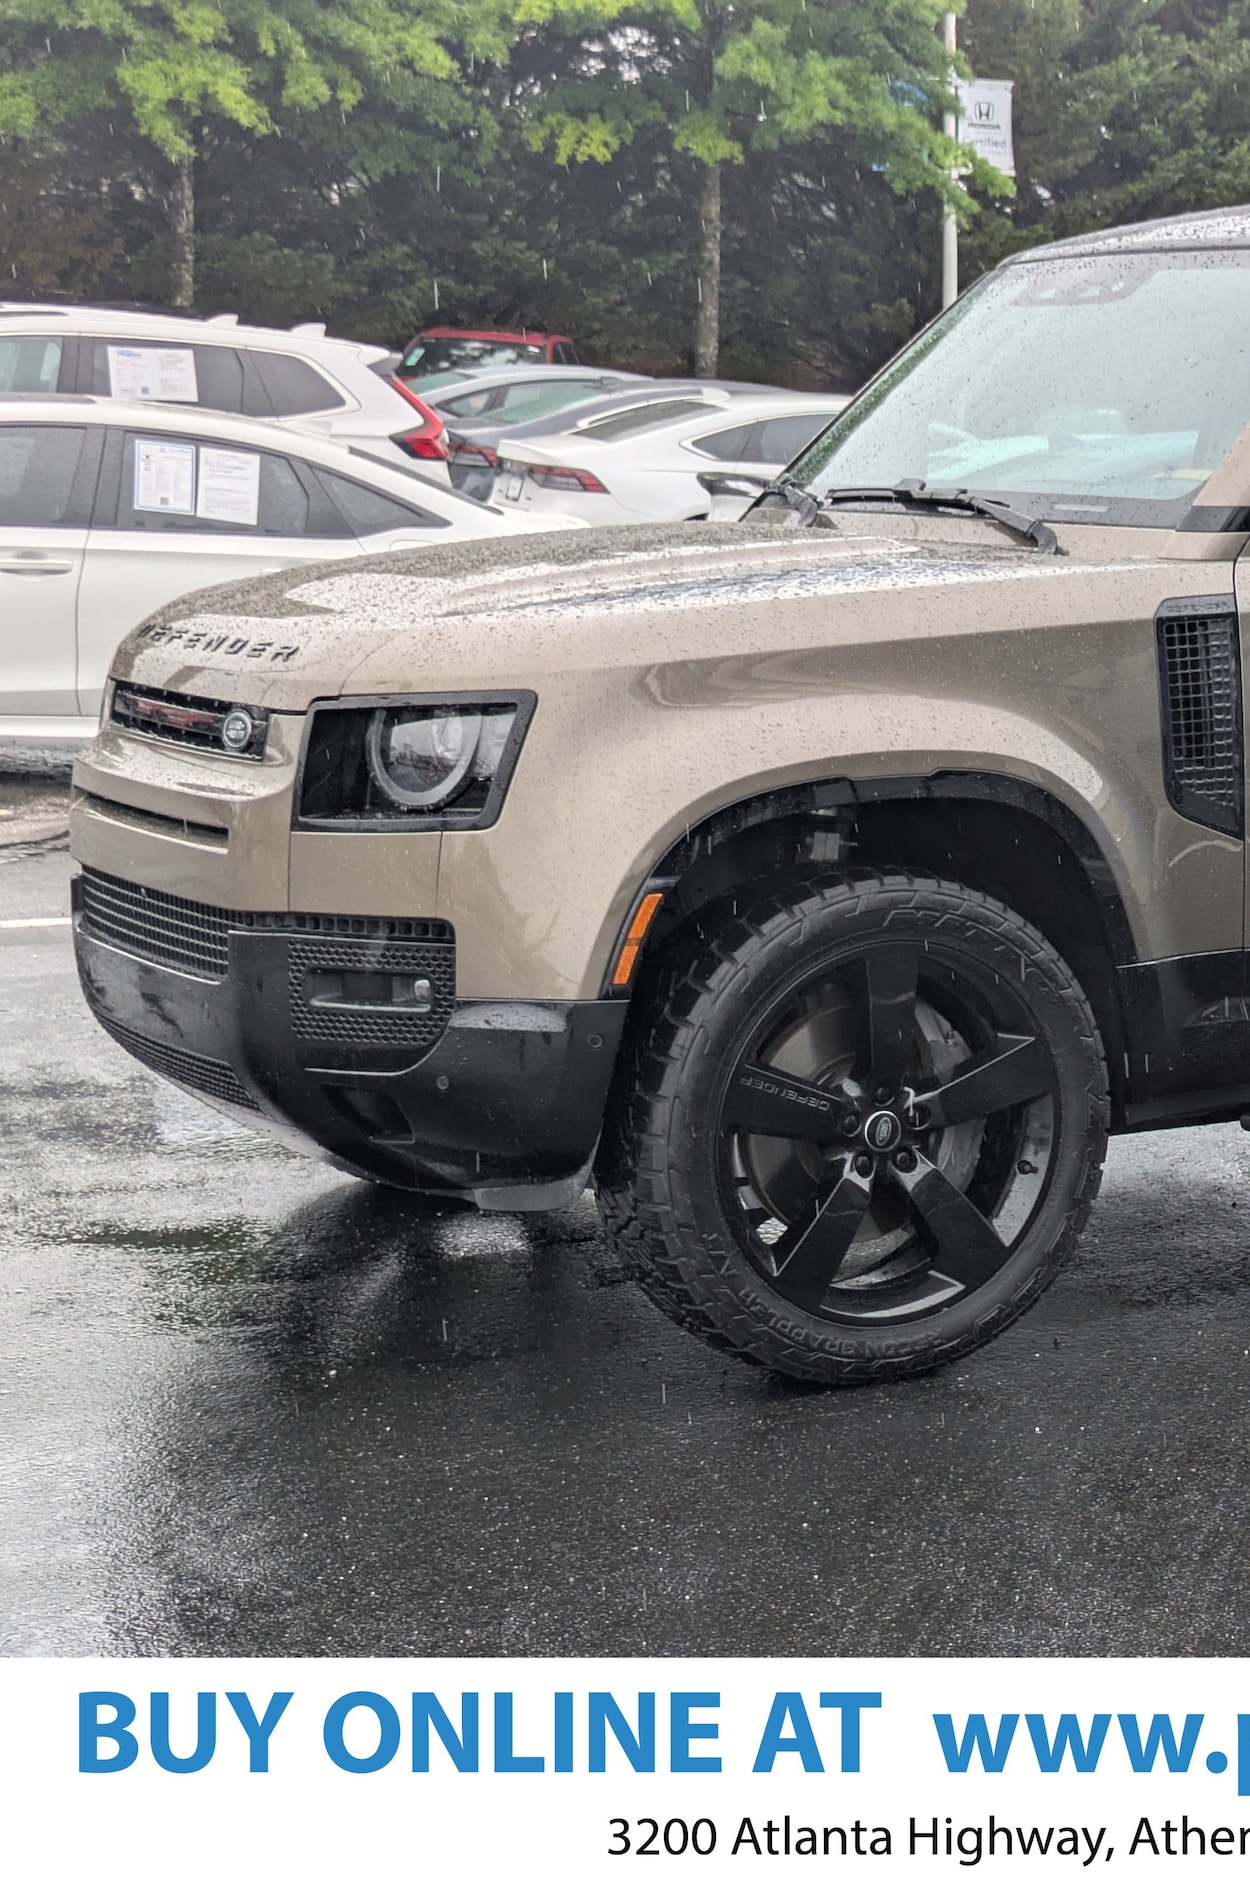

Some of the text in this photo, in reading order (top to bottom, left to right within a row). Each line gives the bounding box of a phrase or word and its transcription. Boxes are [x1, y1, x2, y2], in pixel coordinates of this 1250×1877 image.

[967, 122, 1001, 131] HONDA
[962, 137, 1007, 149] Crtified
[137, 623, 300, 663] DEFENDER
